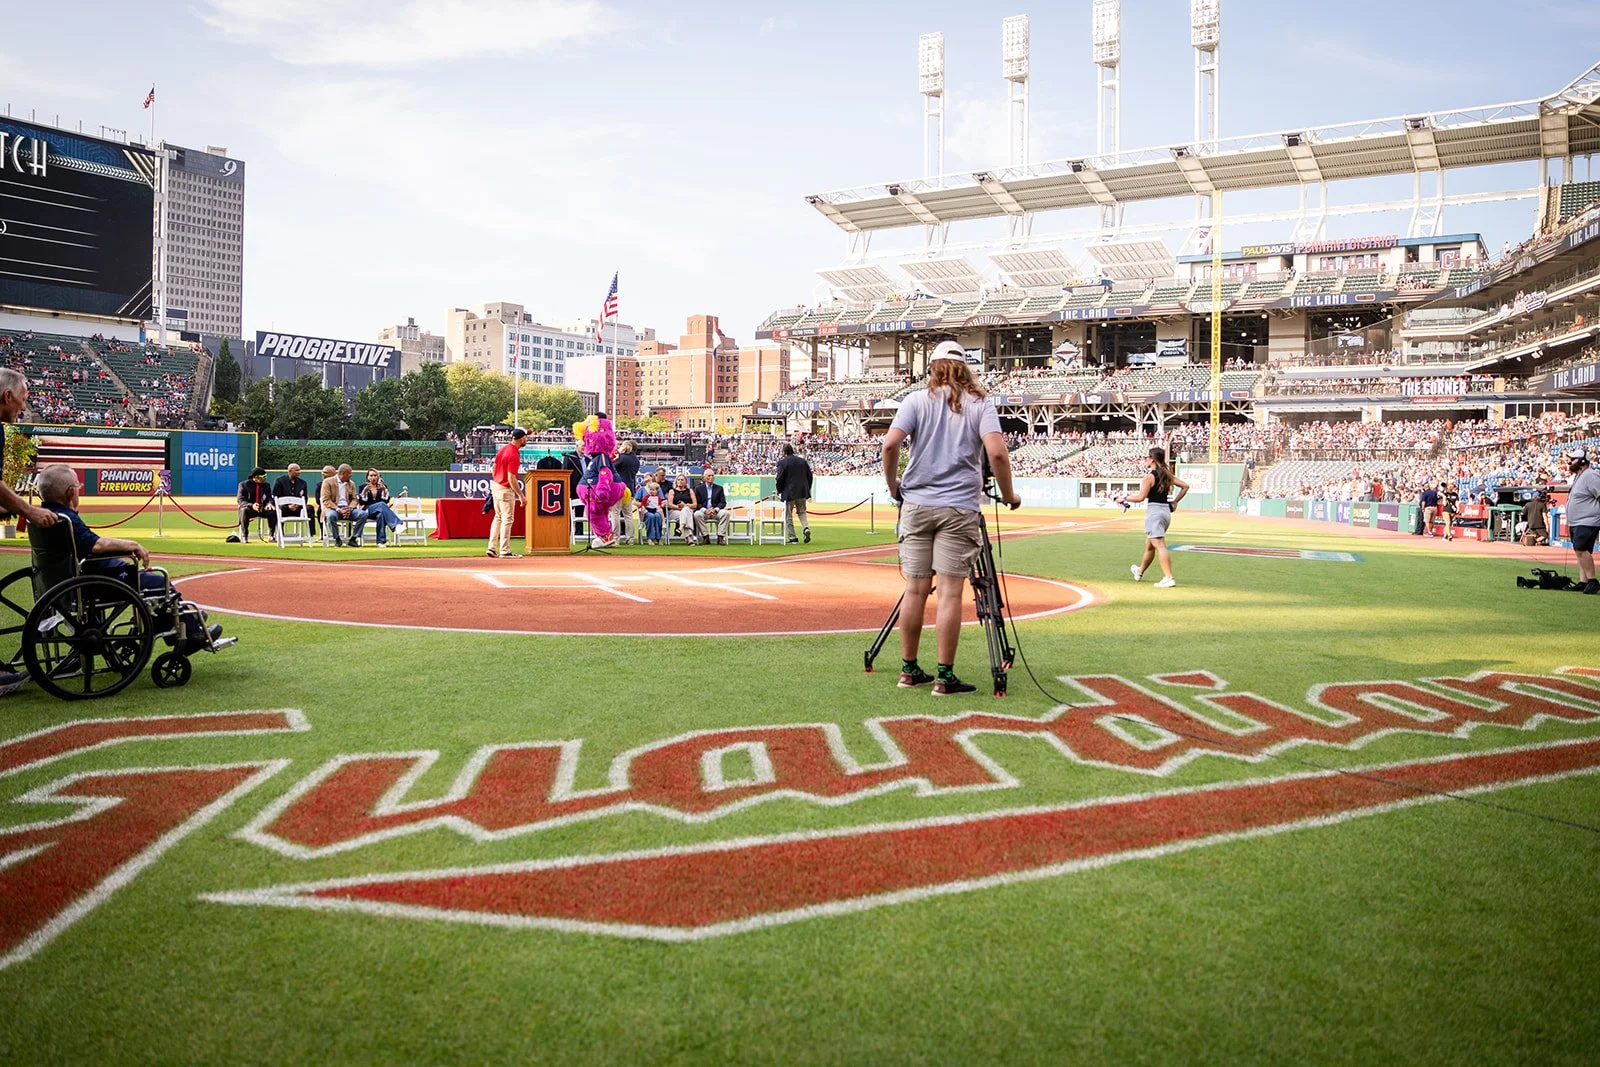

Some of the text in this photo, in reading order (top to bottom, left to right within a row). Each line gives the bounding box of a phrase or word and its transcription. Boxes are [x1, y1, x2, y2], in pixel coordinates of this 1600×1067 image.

[1297, 234, 1399, 254] PENNANT DISTRICT
[1289, 294, 1347, 307] THE LAND
[1060, 308, 1108, 320] THE LAND
[866, 321, 907, 332] THE LAND
[258, 333, 394, 368] PROGRESSIVE
[1553, 364, 1596, 389] THE LAND
[1401, 380, 1422, 396] THE
[1423, 380, 1467, 396] CORNER
[1169, 391, 1191, 401] THE
[776, 402, 814, 411] THE LAND
[32, 426, 72, 434] PROGRESSIVE
[85, 428, 122, 436] PROGRESSIVE
[136, 430, 171, 438] PROGRESSIVE
[184, 448, 236, 471] meijer
[100, 470, 153, 482] PHANTOM
[1182, 470, 1208, 483] drug
[100, 482, 153, 492] FIREWORKS
[449, 479, 495, 493] UNIO
[541, 482, 562, 513] C
